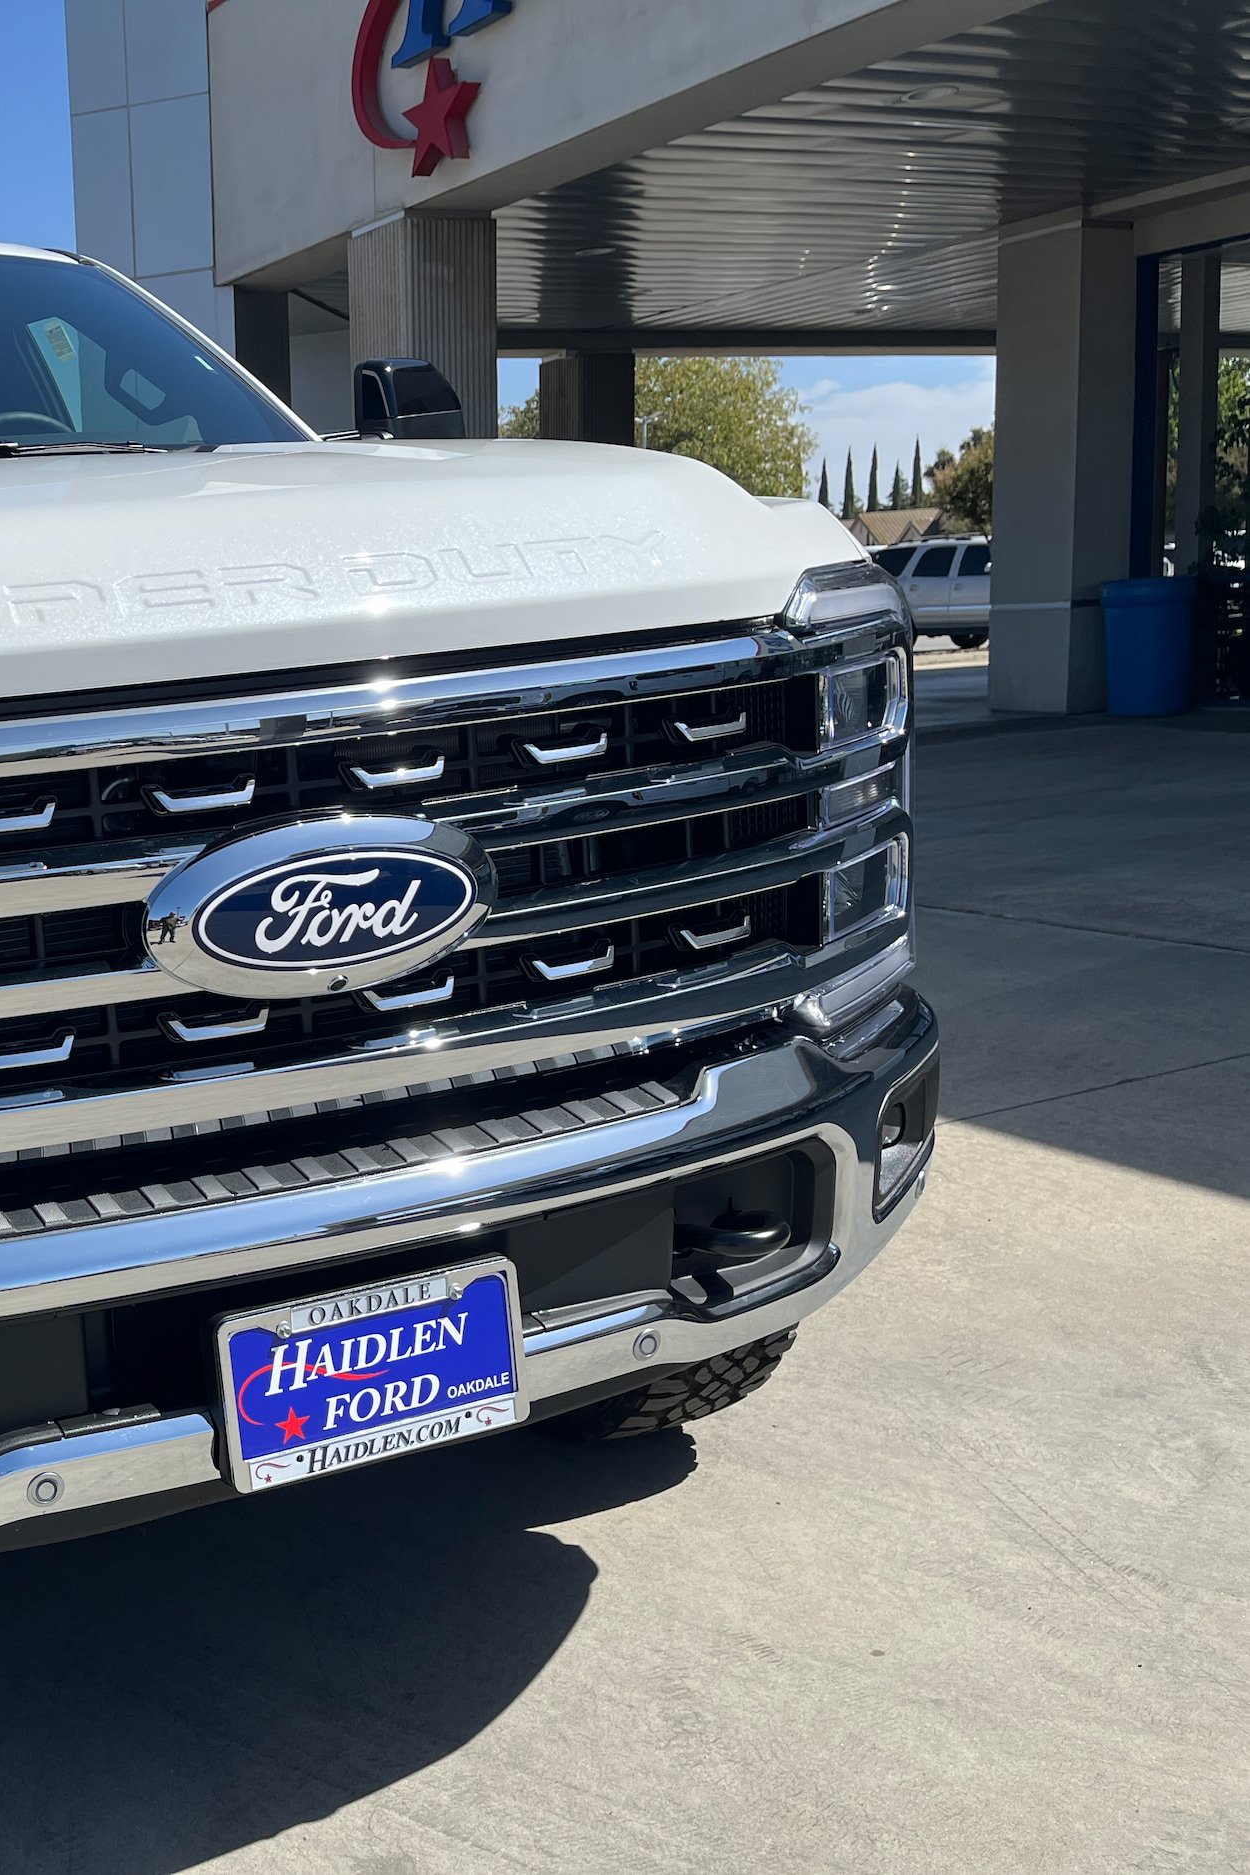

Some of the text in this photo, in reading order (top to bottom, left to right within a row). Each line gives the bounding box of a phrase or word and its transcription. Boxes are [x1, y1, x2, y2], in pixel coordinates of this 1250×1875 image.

[342, 529, 666, 595] DUTY
[254, 868, 422, 954] Ford
[308, 1282, 431, 1327] OAKDALE
[264, 1312, 468, 1397] HAIDLEN
[322, 1374, 440, 1432] FORD
[447, 1371, 510, 1399] OAKDALE
[306, 1416, 461, 1474] HAIDLEN.COM
